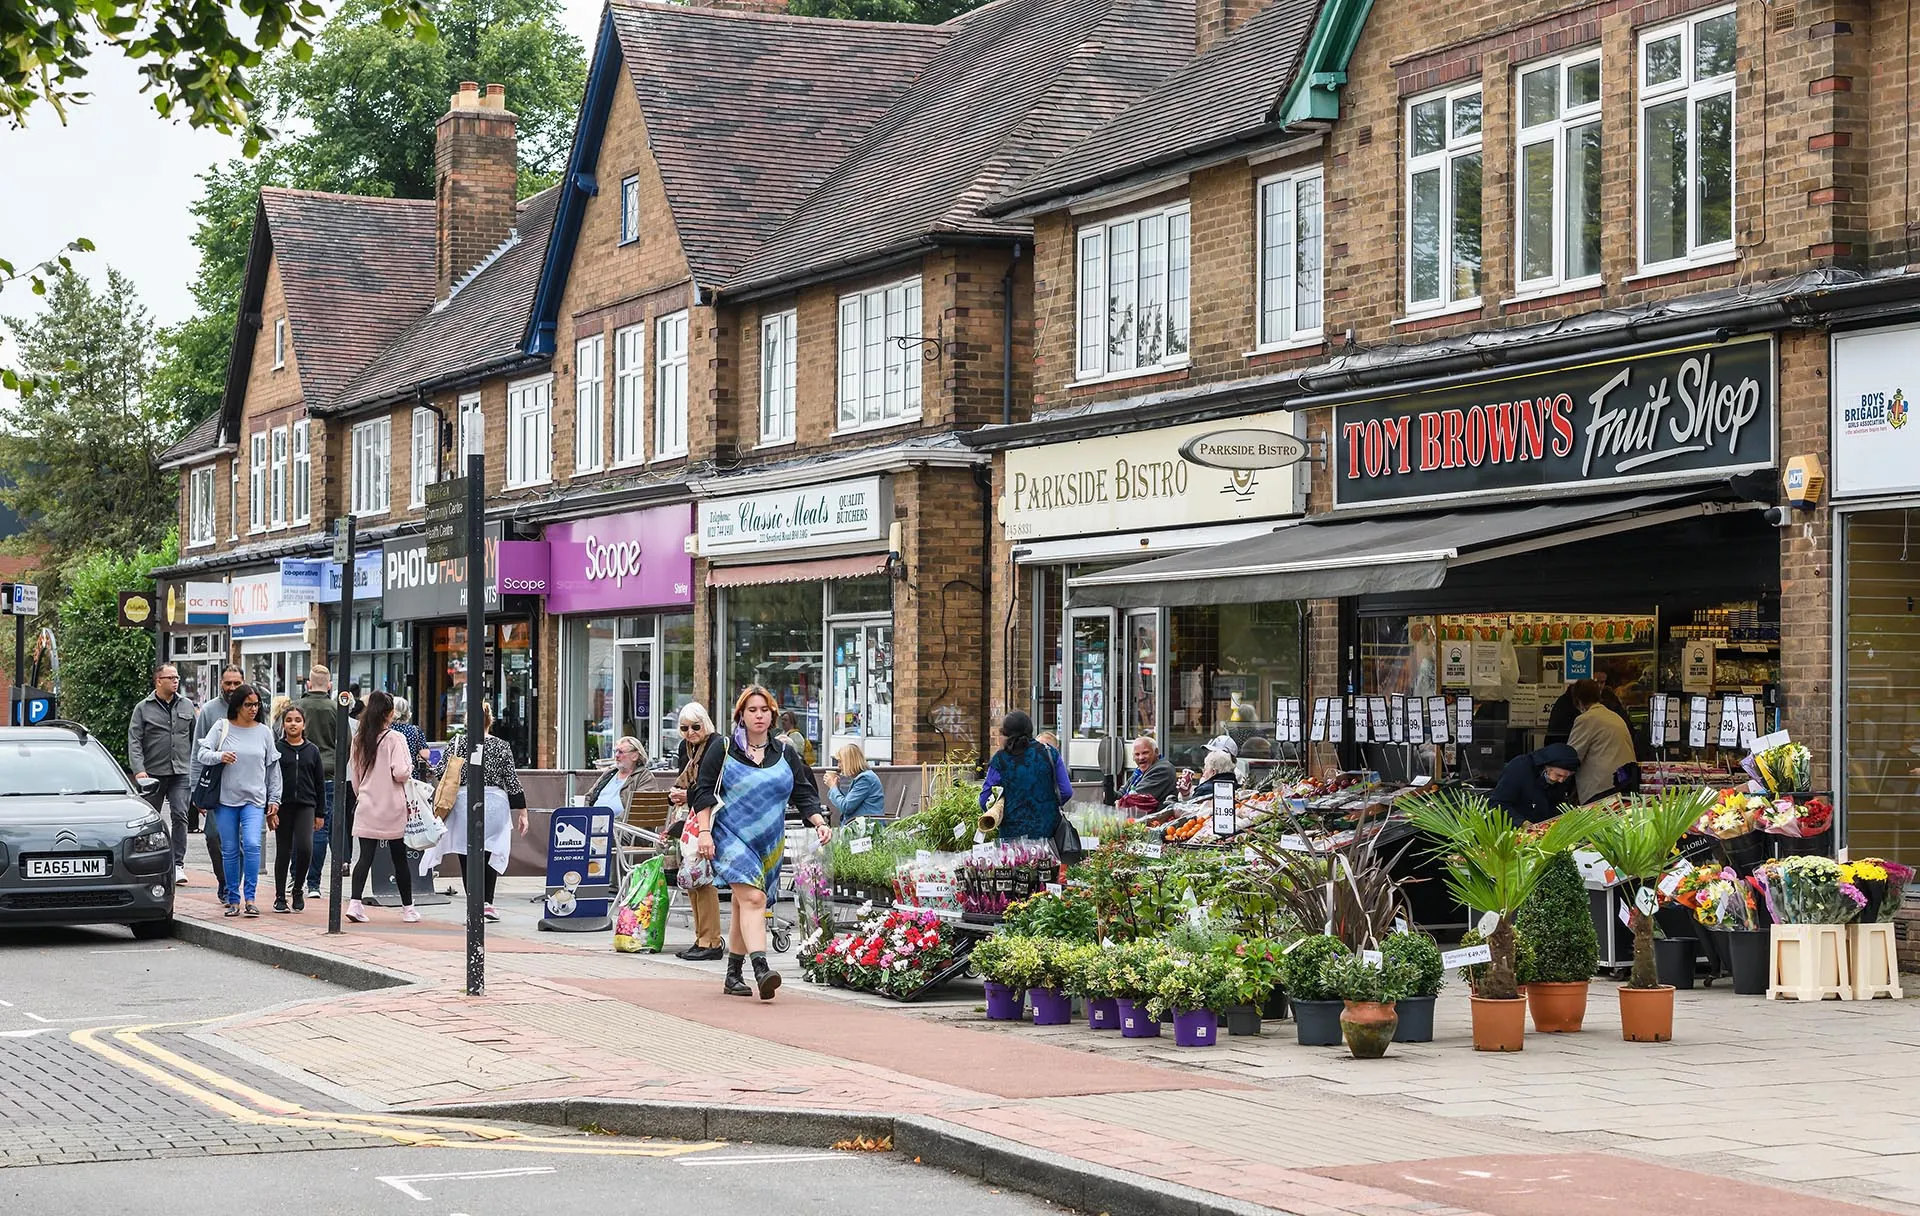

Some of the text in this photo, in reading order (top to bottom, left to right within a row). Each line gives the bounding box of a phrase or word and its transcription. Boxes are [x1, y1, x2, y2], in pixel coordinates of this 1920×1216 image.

[1861, 392, 1885, 407] BOYS
[1343, 353, 1760, 479] TOM BROWN'S Fruit Shop
[1844, 405, 1885, 422] BRIGADE
[1860, 419, 1885, 427] ASSOCIATION
[1200, 443, 1298, 456] PARKSIDE BISTRO
[1014, 458, 1188, 512] PARKSIDE BISTRO
[1788, 472, 1802, 485] ADT
[448, 501, 464, 515] Centre
[839, 492, 866, 510] QUALITY
[738, 494, 829, 532] Classic Meats
[836, 508, 869, 524] BUTCHERS
[425, 523, 454, 540] Health Centre
[387, 547, 438, 590] PHOTO
[439, 536, 497, 584] FACRY
[585, 534, 641, 588] Scope
[503, 577, 545, 591] Scope
[674, 583, 689, 596] Shirley
[15, 587, 22, 601] P
[233, 582, 268, 616] acrns
[189, 598, 229, 608] acrns
[31, 701, 44, 719] P
[1665, 719, 1679, 729] £1
[1722, 719, 1737, 733] 99p
[1740, 720, 1757, 733] 2-£1
[1215, 807, 1234, 817] £1.99
[1684, 838, 1708, 851] LORIA
[34, 860, 100, 874] EA65 LNM
